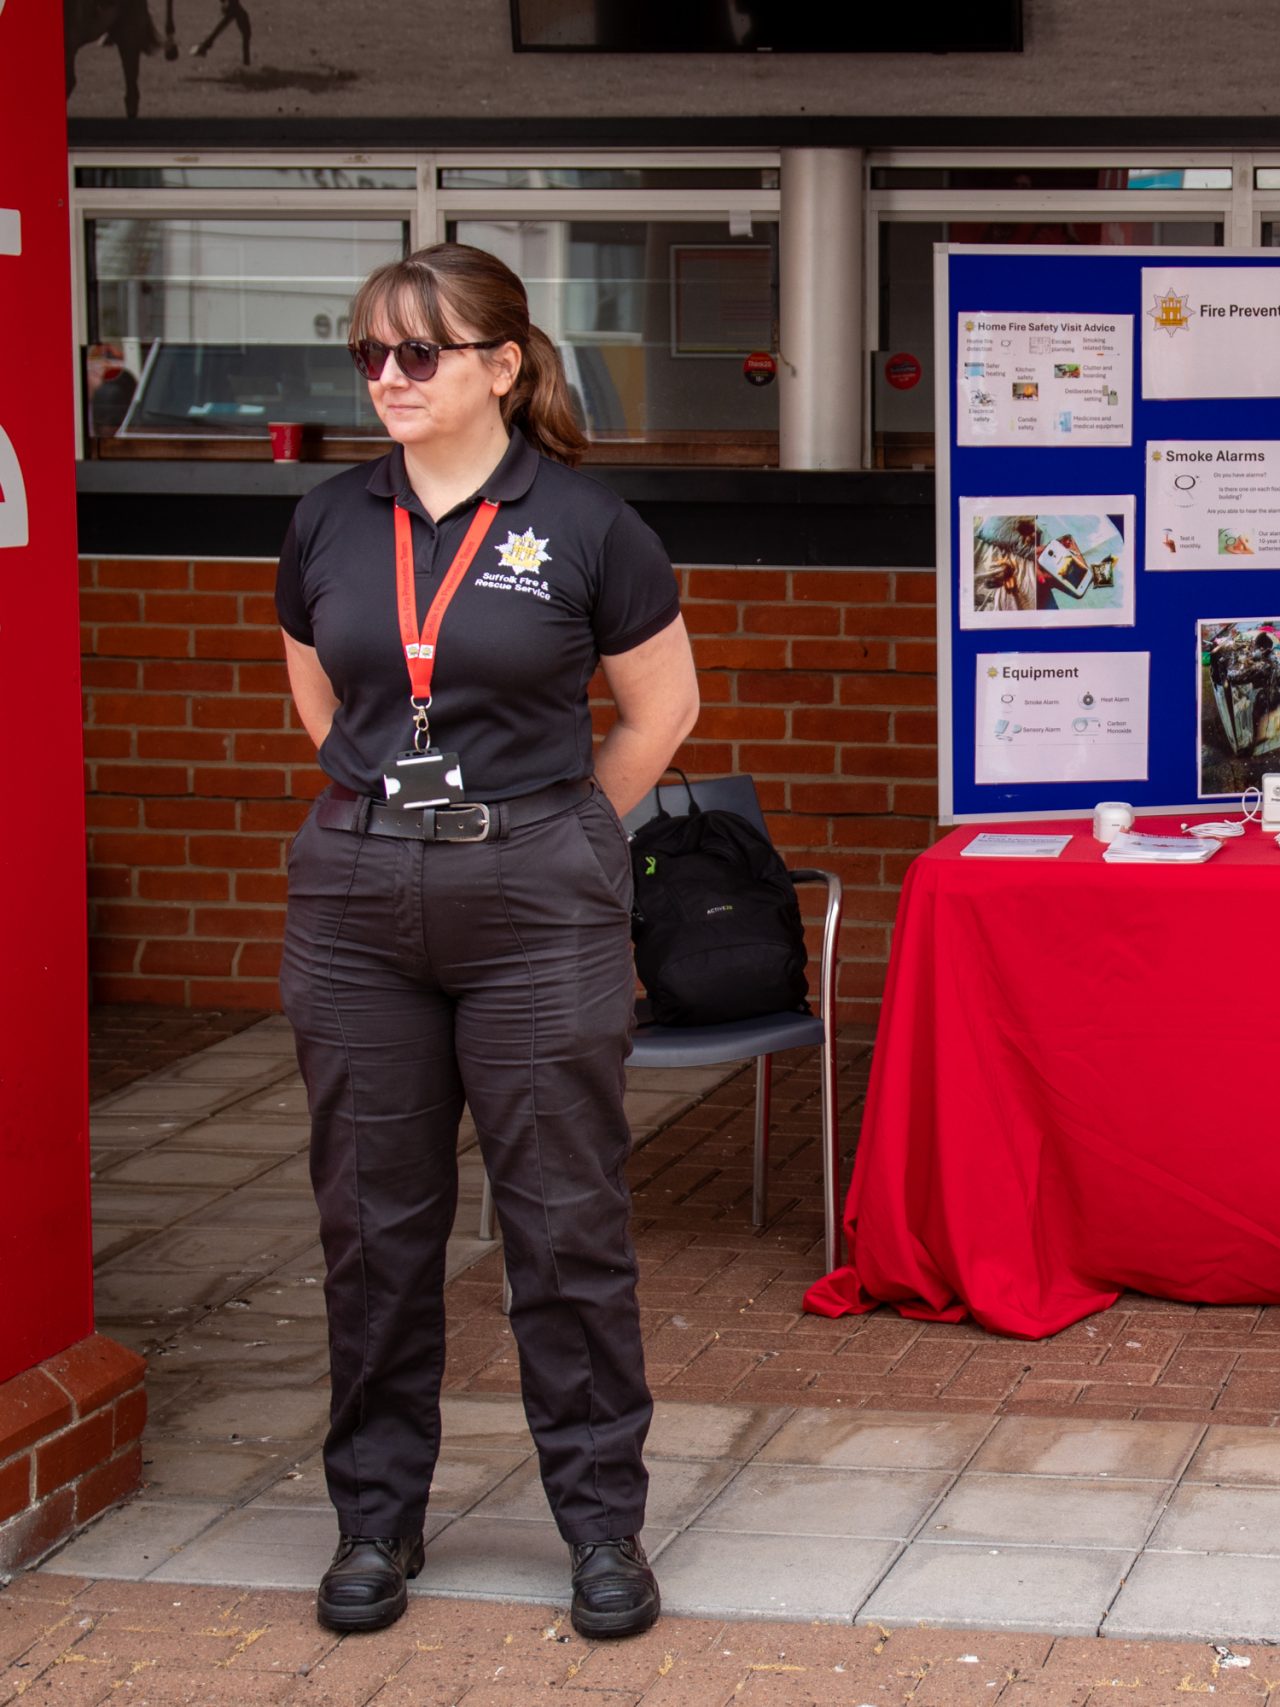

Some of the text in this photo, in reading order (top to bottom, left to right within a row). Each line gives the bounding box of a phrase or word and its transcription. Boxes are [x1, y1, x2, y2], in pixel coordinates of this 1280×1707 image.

[1200, 305, 1225, 317] Fire
[978, 322, 1116, 334] Home Fire Safety Visit Advice
[986, 370, 1006, 378] heating
[1096, 423, 1124, 431] equipment
[1166, 450, 1265, 462] Smoke Alarms
[440, 559, 465, 598] Prevention
[483, 572, 549, 591] Suffolk Fire &
[475, 578, 551, 601] Rescue Service
[1002, 667, 1079, 681] Equipment
